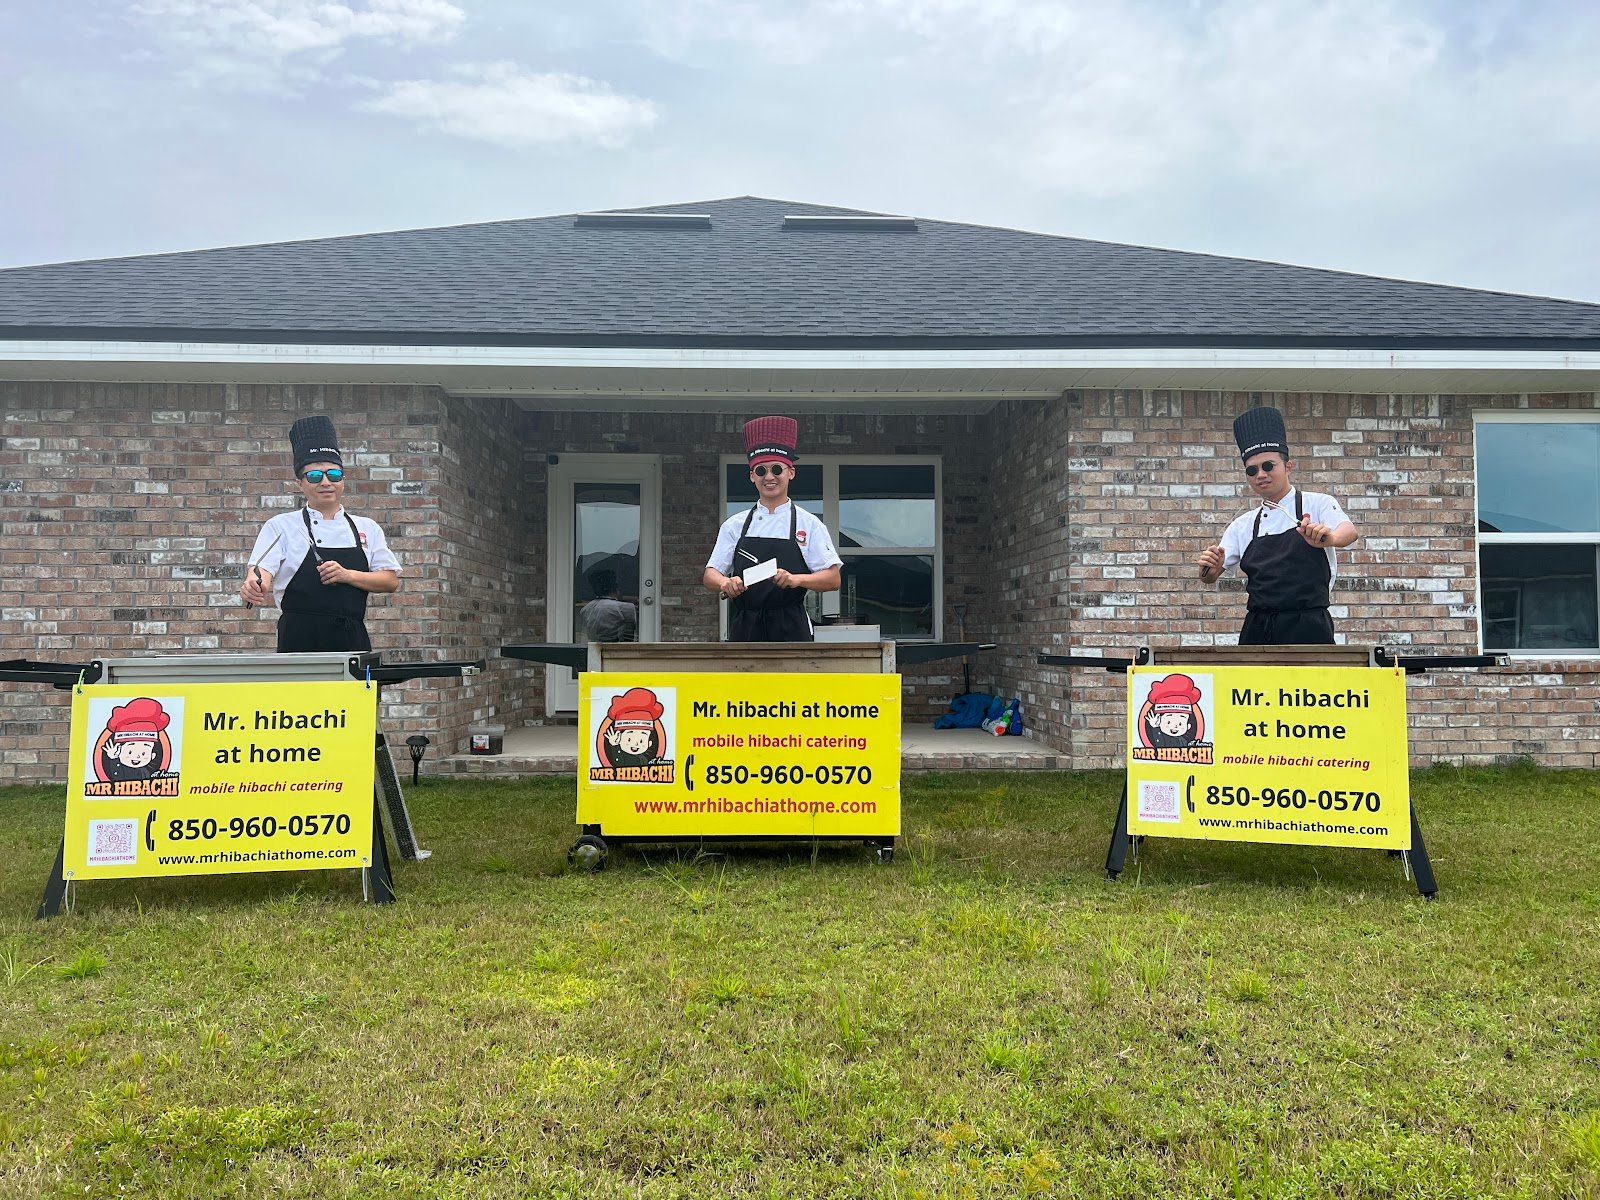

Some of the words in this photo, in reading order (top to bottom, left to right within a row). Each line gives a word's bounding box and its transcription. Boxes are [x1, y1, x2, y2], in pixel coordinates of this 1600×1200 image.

[1231, 688, 1271, 707] Mr.
[1278, 688, 1369, 708] hibachi
[693, 701, 721, 718] Mr.
[726, 700, 796, 718] hibachi
[801, 702, 821, 718] at
[825, 701, 879, 719] home
[203, 712, 245, 731] Mr.
[254, 709, 346, 730] hibachi
[1243, 721, 1269, 738] at
[1276, 719, 1346, 740] home
[692, 734, 744, 748] mobile
[748, 734, 802, 748] hibachi
[805, 734, 867, 751] catering
[214, 746, 242, 764] at
[249, 743, 321, 763] home
[1133, 748, 1156, 759] MR
[1157, 747, 1213, 764] HIBACHI
[1222, 754, 1265, 765] mobile
[1267, 755, 1314, 767] hibachi
[1317, 757, 1370, 772] catering
[159, 769, 180, 778] home
[590, 768, 615, 780] MR
[615, 765, 674, 783] HIBACHI
[705, 765, 872, 785] 850-960-0570
[86, 782, 113, 796] MR
[113, 778, 178, 796] HIBACHI
[189, 782, 235, 795] mobile
[238, 780, 287, 793] hibachi
[289, 779, 343, 793] catering
[634, 797, 877, 814] www.mrhibachiathome.com
[1206, 785, 1381, 813] 850-960-0570
[168, 813, 351, 841] 850-960-0570
[1198, 816, 1389, 836] www.mrhibachiathome.com
[158, 847, 356, 866] www.mrhibachiathome.com
